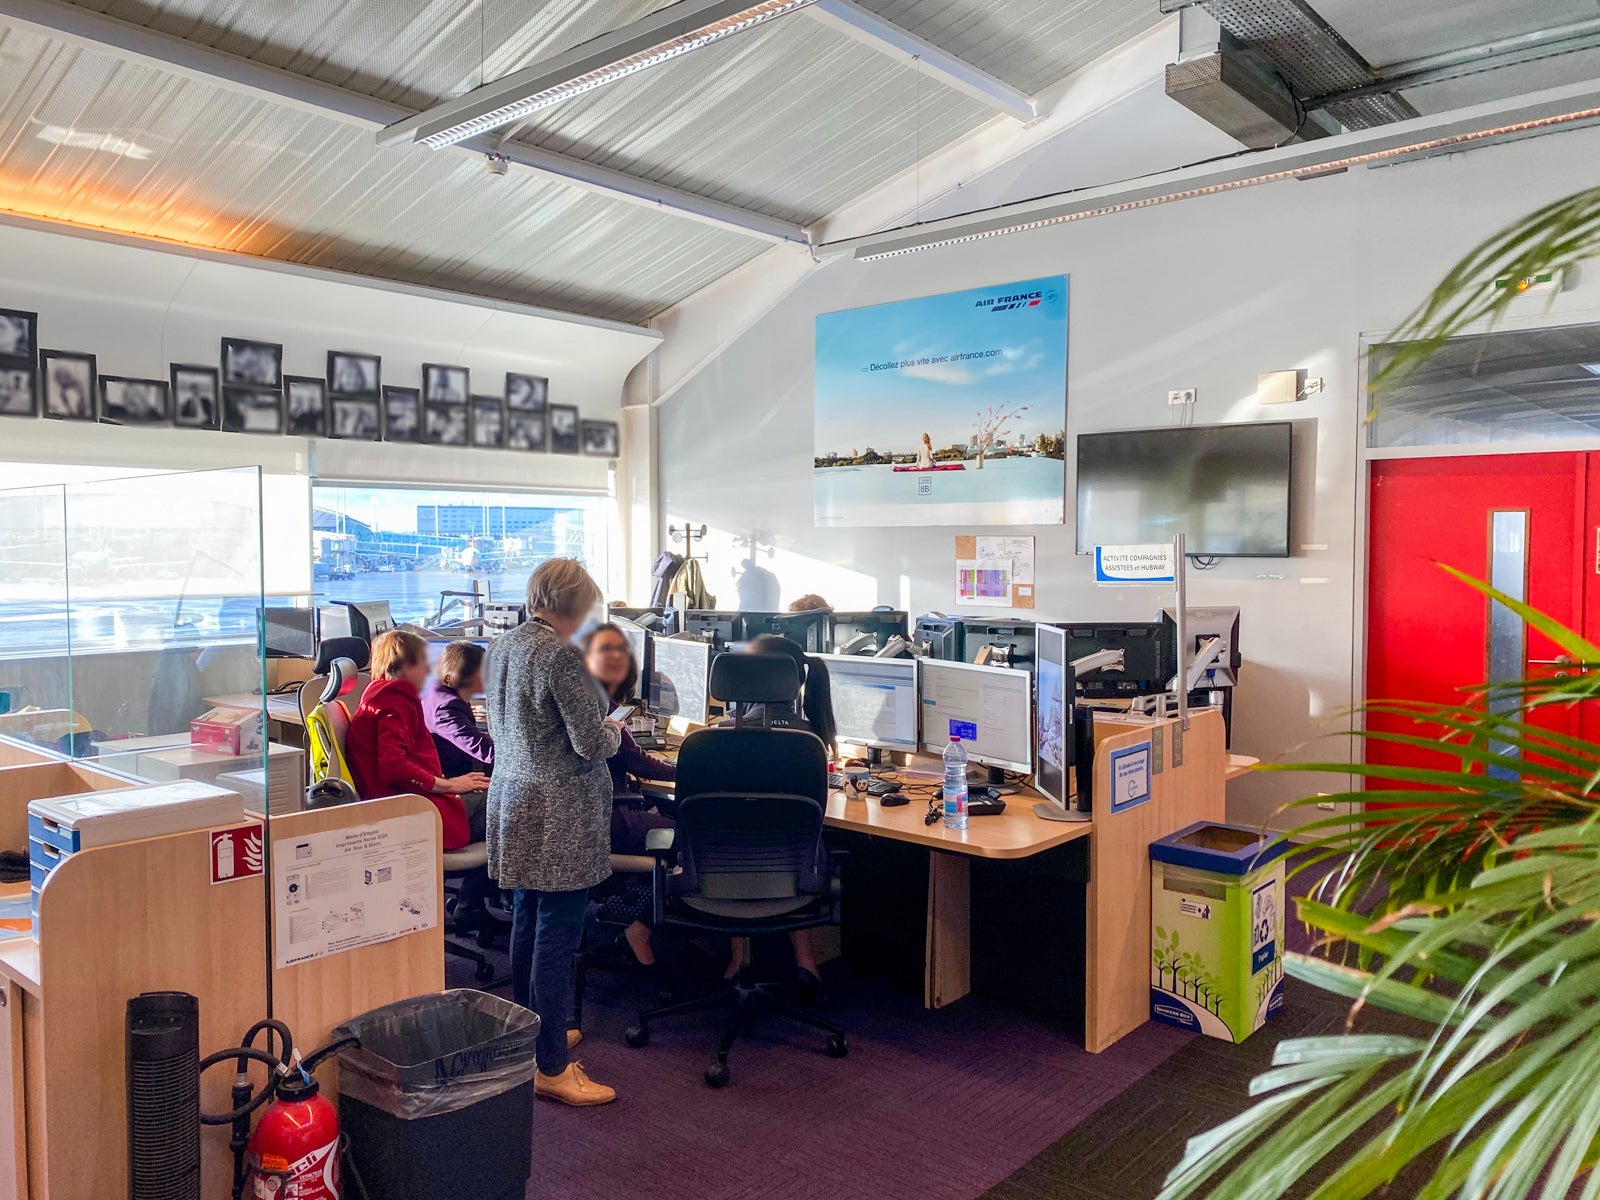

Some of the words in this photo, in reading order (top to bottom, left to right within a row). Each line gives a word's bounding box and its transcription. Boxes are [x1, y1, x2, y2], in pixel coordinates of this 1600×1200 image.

[975, 298, 994, 307] AIR
[997, 291, 1042, 304] FRANCE
[870, 361, 899, 371] Décollez
[900, 359, 915, 369] plus
[917, 357, 930, 366] vite
[931, 355, 949, 364] avec
[950, 348, 1002, 362] airfrance.com
